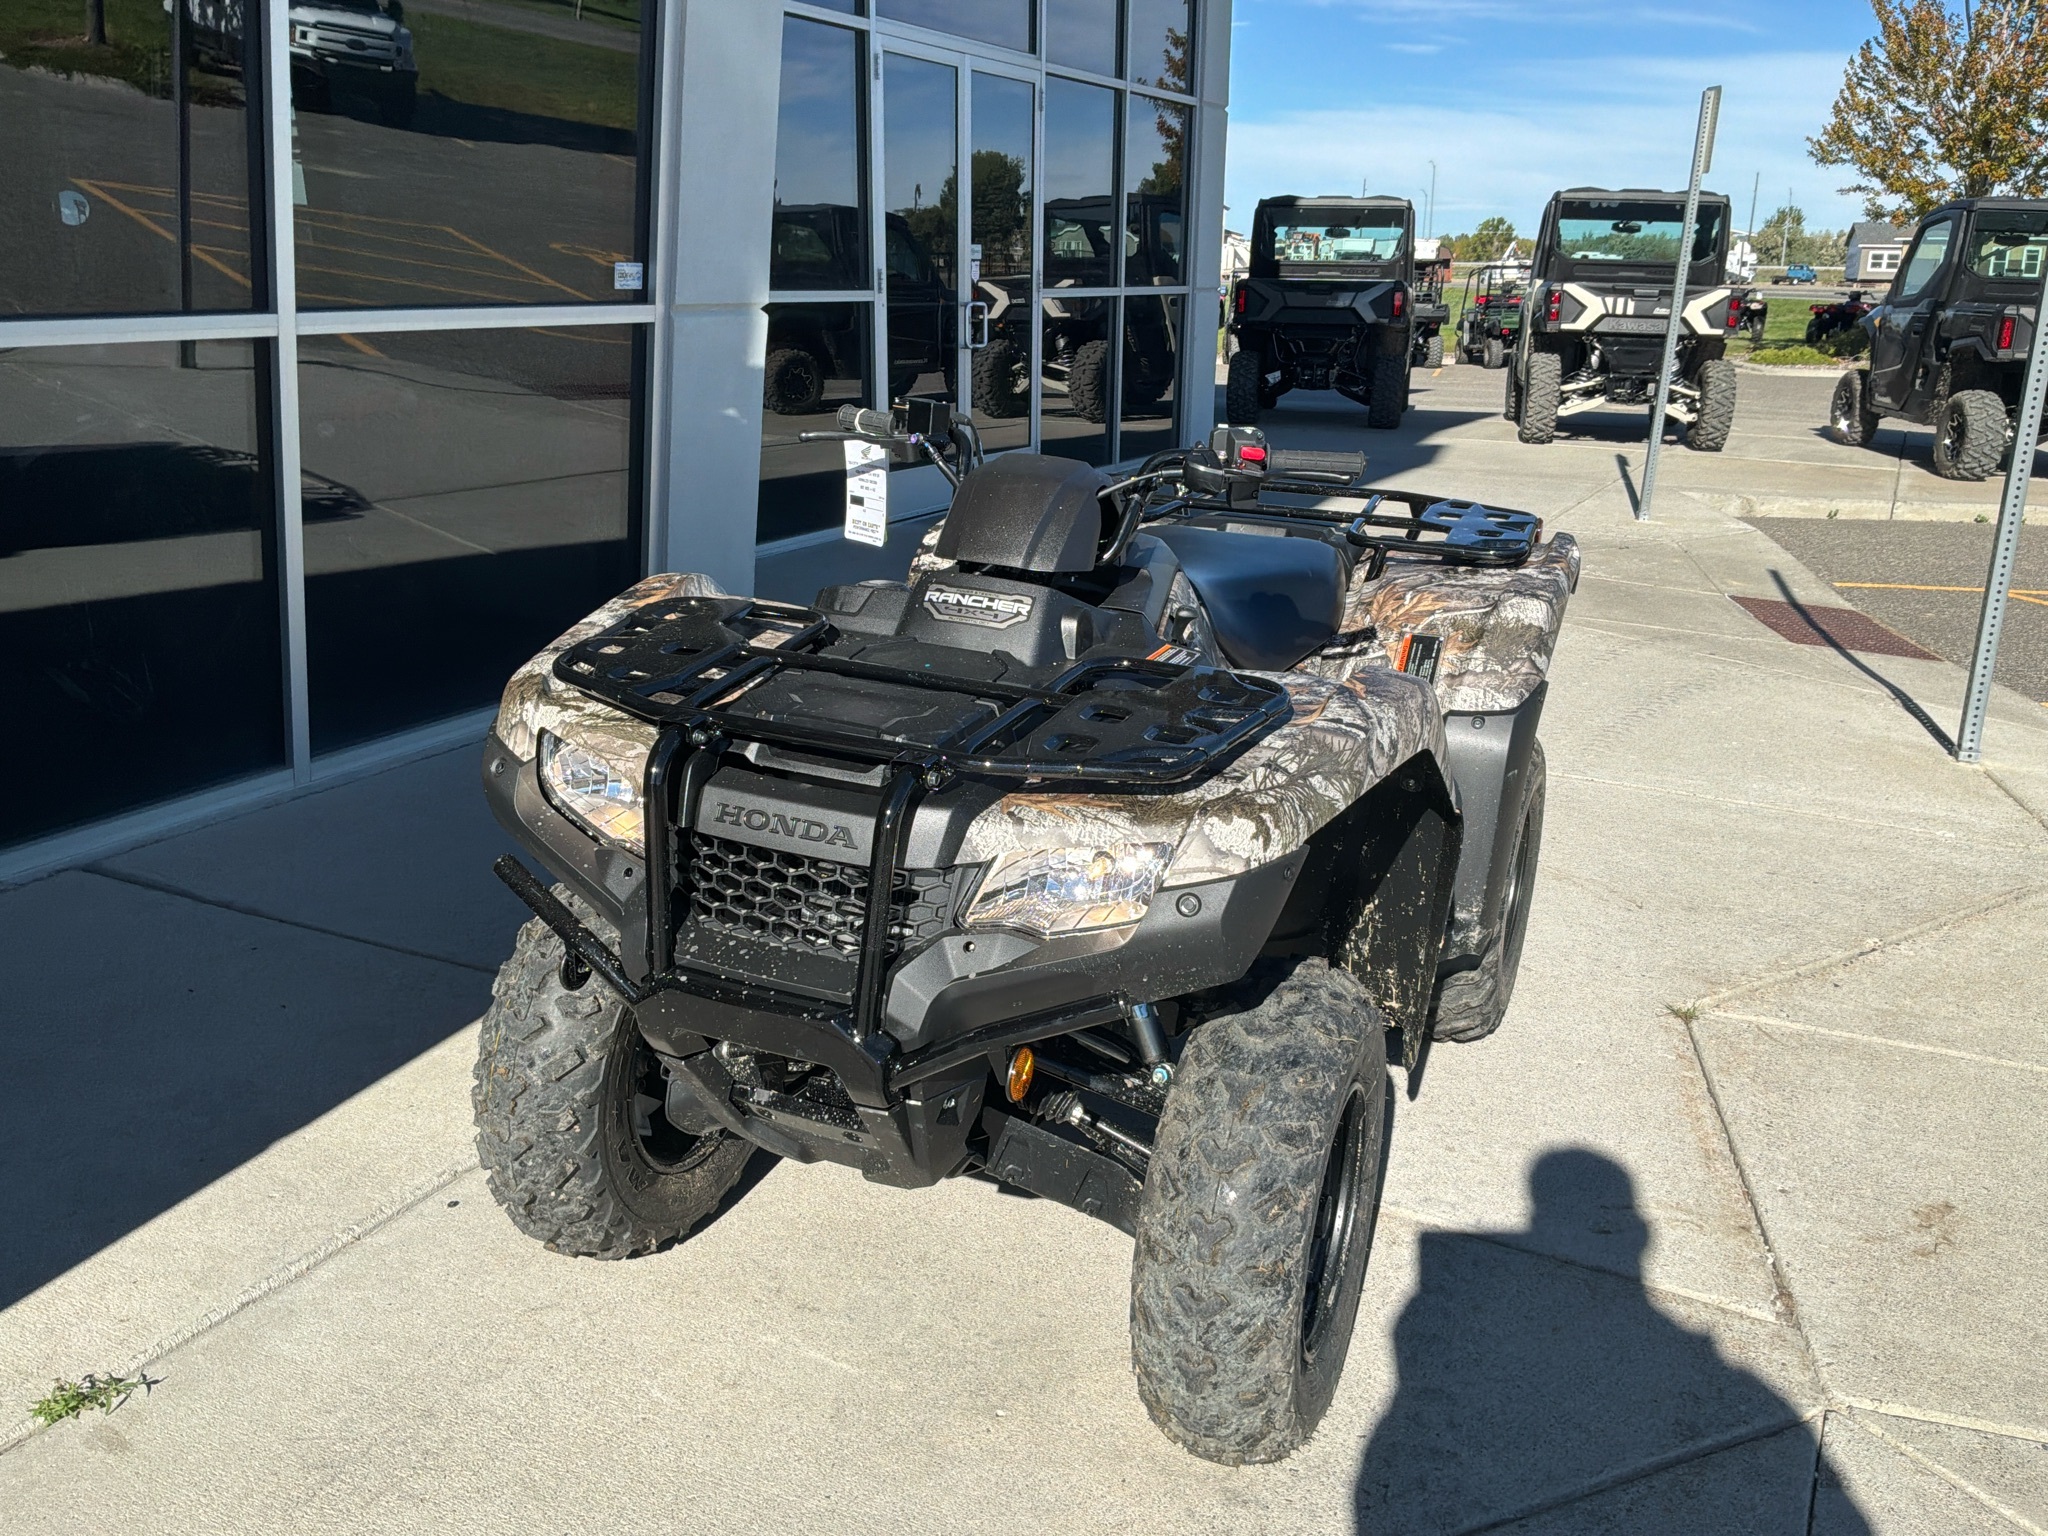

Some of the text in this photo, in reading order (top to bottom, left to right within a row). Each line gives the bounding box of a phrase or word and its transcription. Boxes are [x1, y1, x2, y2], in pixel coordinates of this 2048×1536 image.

[1608, 318, 1668, 332] Kawasa
[924, 591, 1031, 616] RANCHER
[713, 802, 858, 849] HONDA
